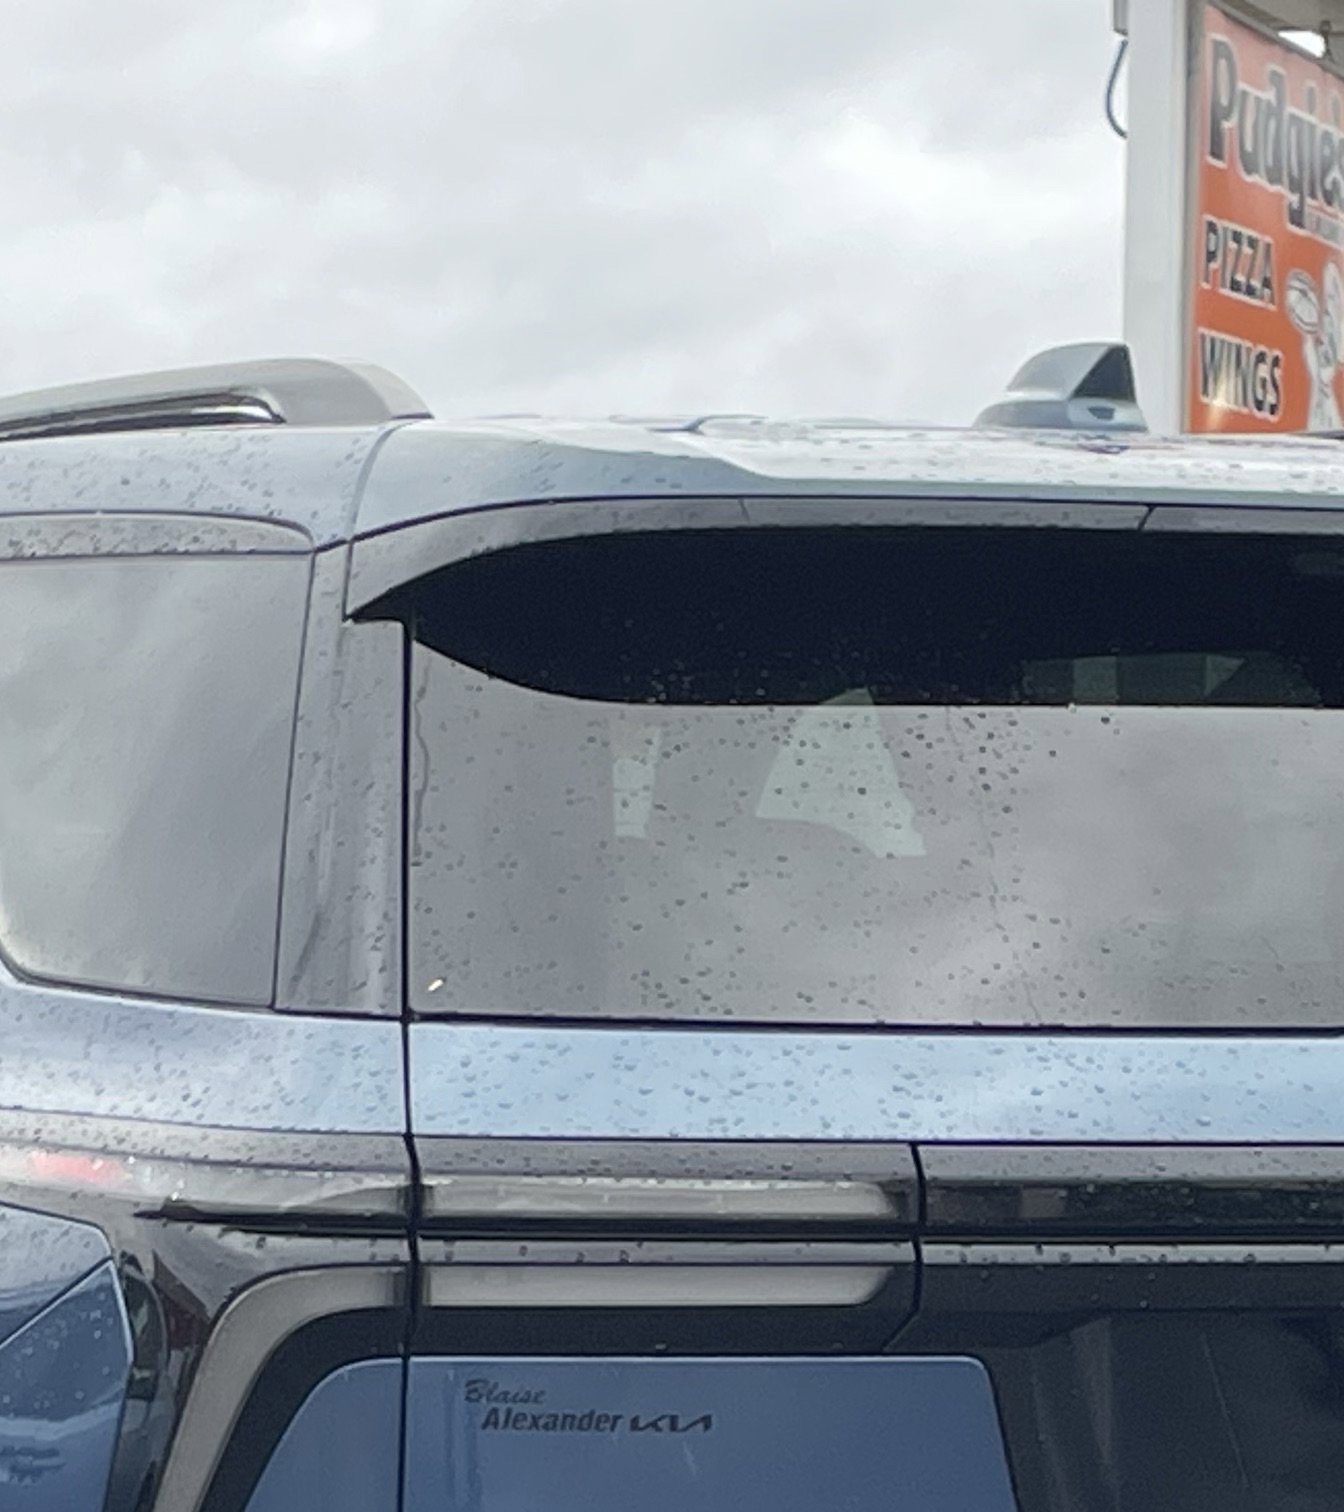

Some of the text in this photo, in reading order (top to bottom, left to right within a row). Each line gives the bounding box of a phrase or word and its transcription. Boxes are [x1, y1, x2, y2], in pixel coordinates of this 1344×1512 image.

[1202, 216, 1276, 309] PIZZA
[1197, 330, 1282, 419] WINGS
[481, 1407, 712, 1433] Alexander KIA
